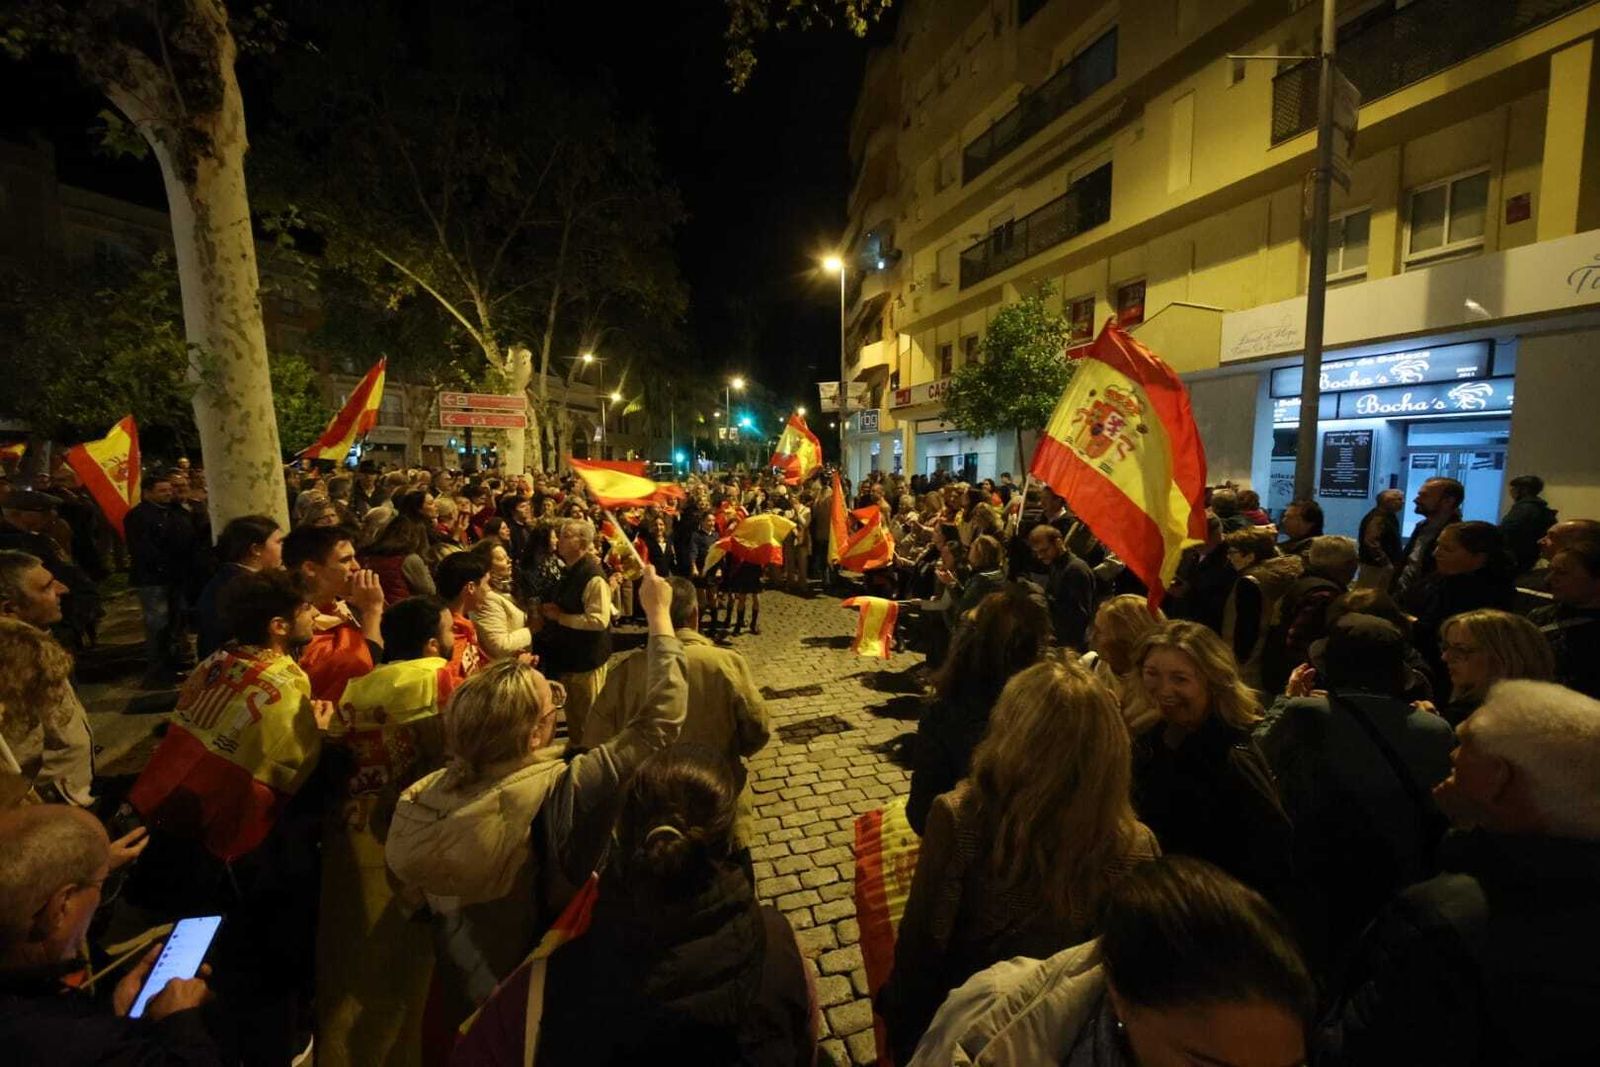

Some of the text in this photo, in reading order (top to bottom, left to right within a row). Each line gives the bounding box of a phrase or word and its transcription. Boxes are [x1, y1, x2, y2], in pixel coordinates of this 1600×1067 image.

[1320, 361, 1355, 371] entro
[1376, 351, 1431, 364] Belleza
[1356, 391, 1447, 415] Bocha's
